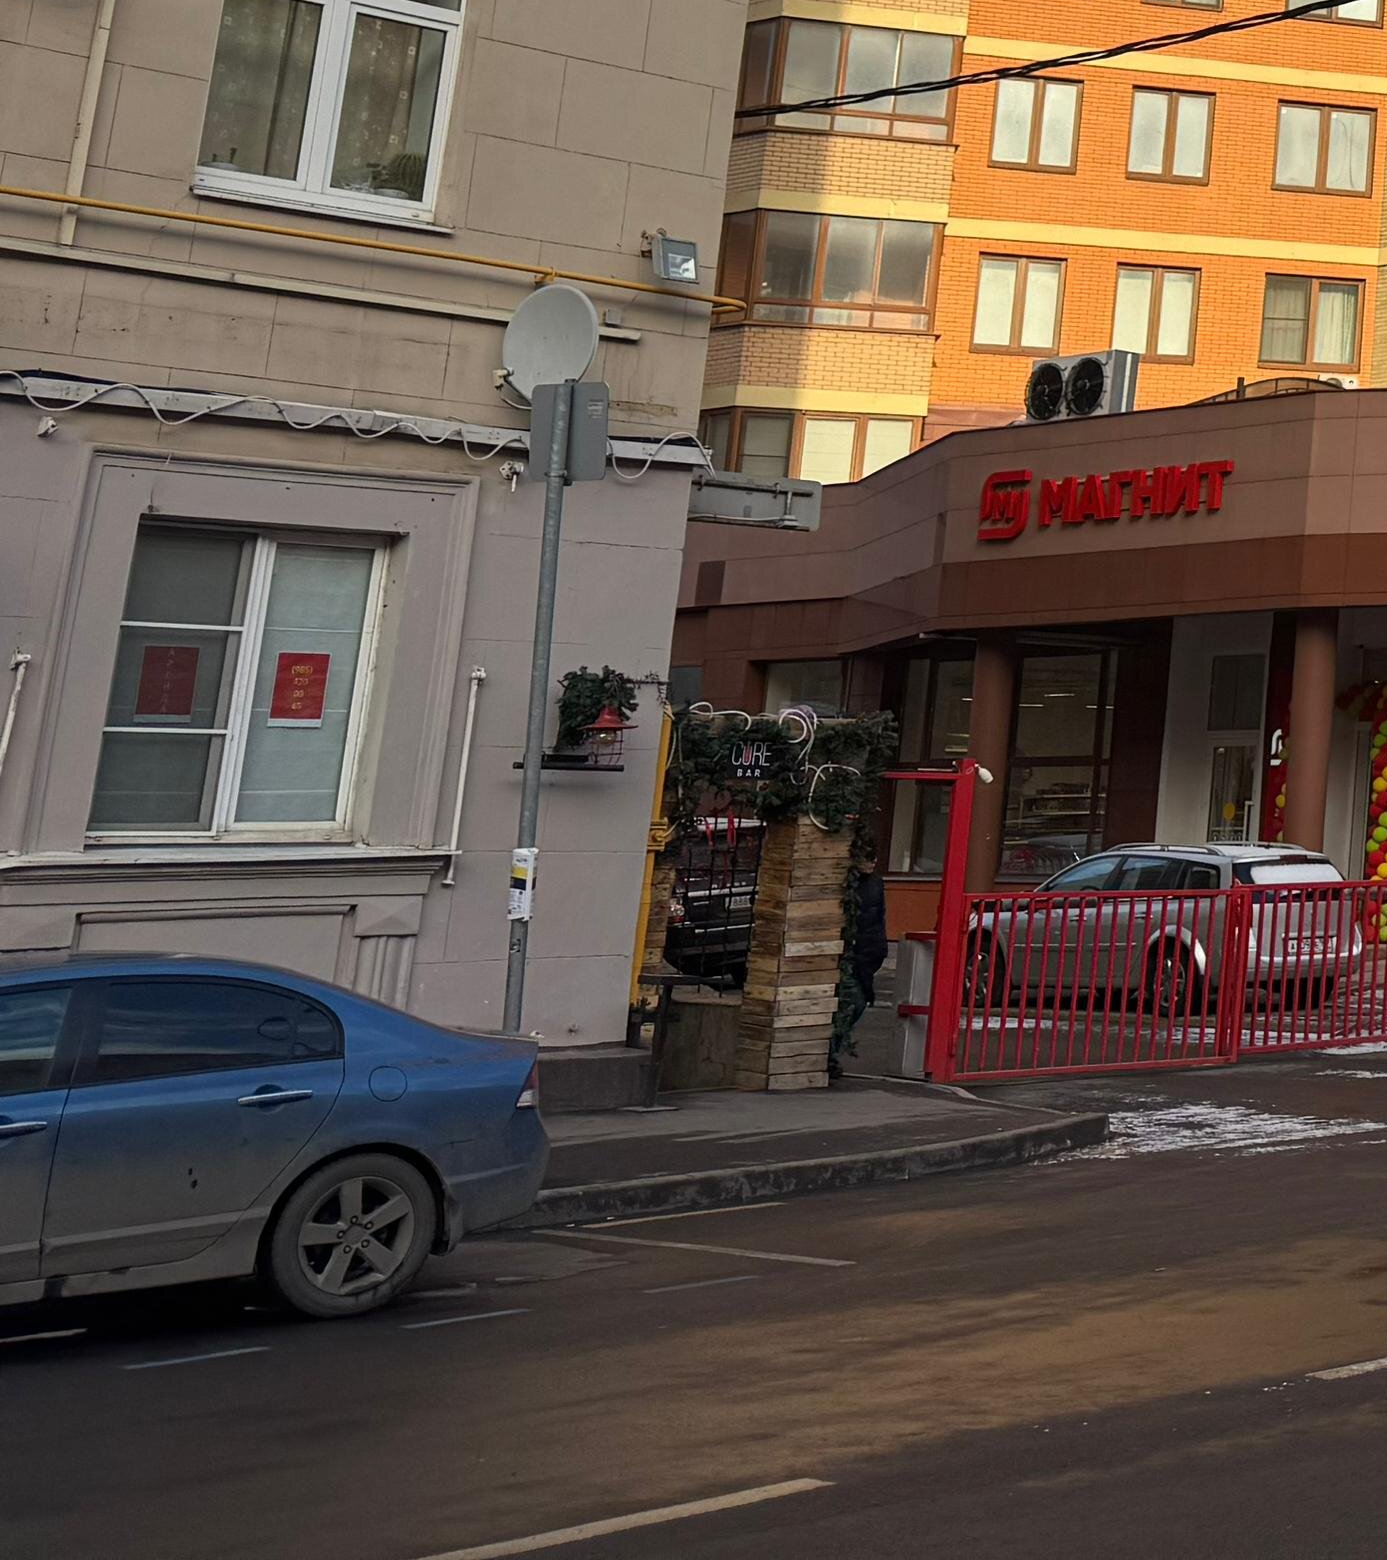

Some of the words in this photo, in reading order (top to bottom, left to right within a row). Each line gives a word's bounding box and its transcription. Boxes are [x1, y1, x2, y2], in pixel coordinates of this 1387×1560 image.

[1038, 459, 1235, 527] МАГНИТ
[731, 741, 772, 766] CURE
[737, 768, 761, 777] BAR
